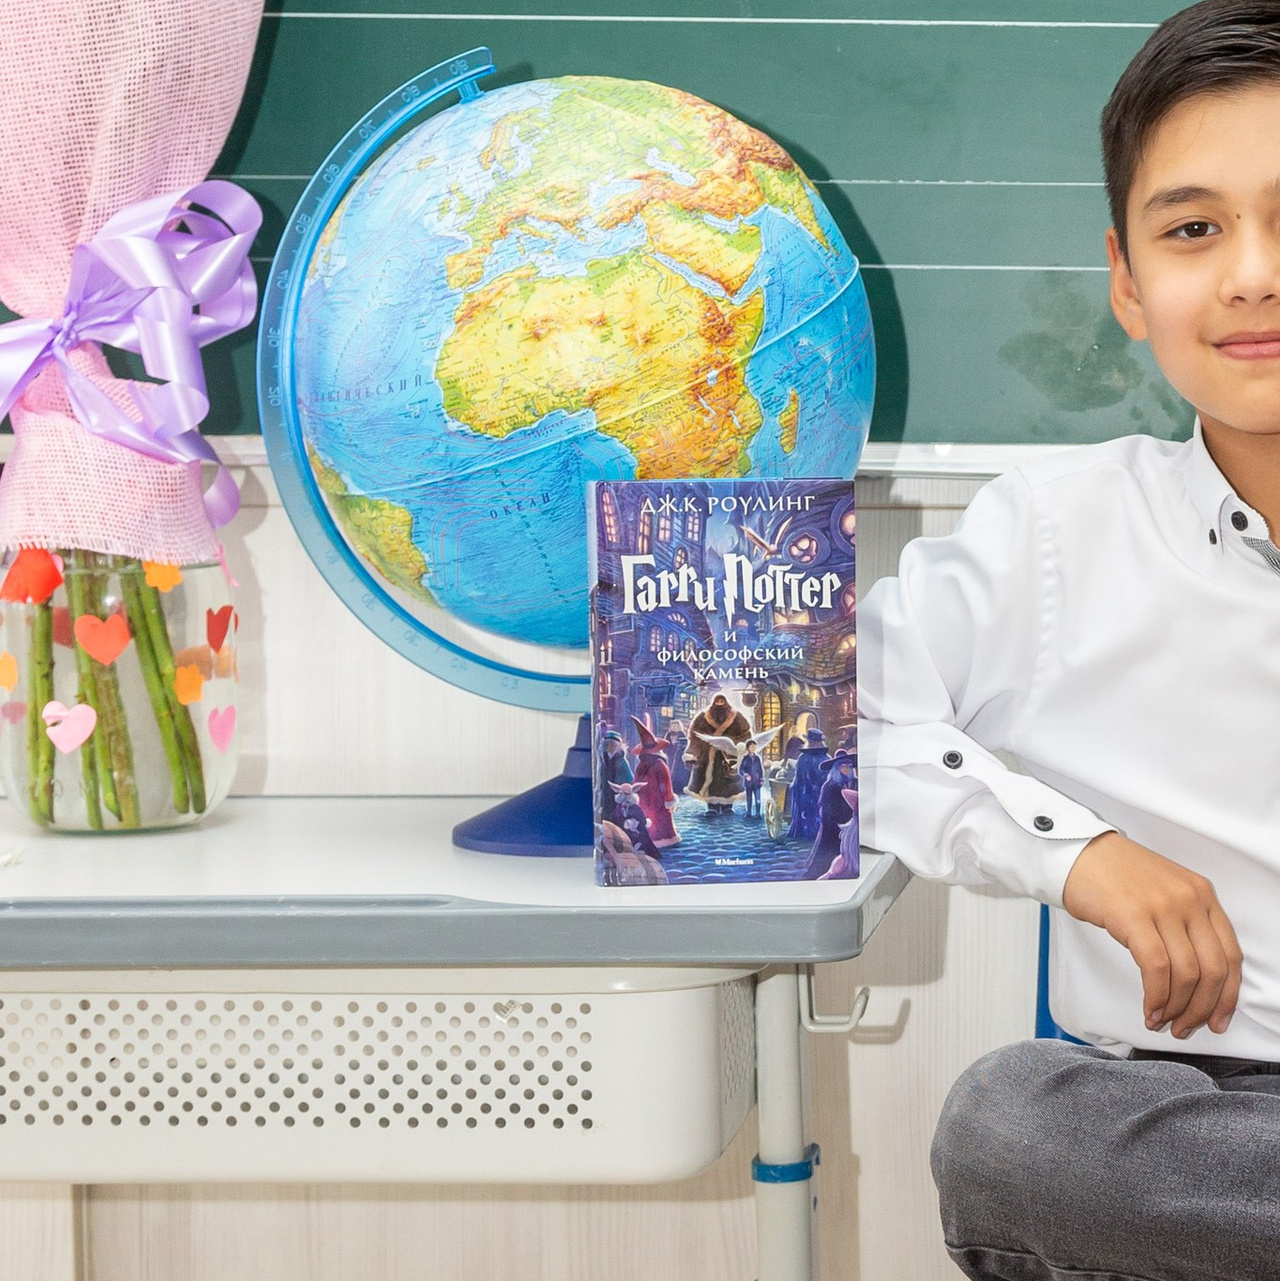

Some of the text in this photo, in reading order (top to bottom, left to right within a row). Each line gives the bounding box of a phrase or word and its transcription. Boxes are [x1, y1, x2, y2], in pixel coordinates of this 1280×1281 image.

[489, 492, 551, 520] ОКЕАН
[707, 494, 816, 517] РОУЛИНГ
[693, 668, 769, 680] КАМЕНЬ
